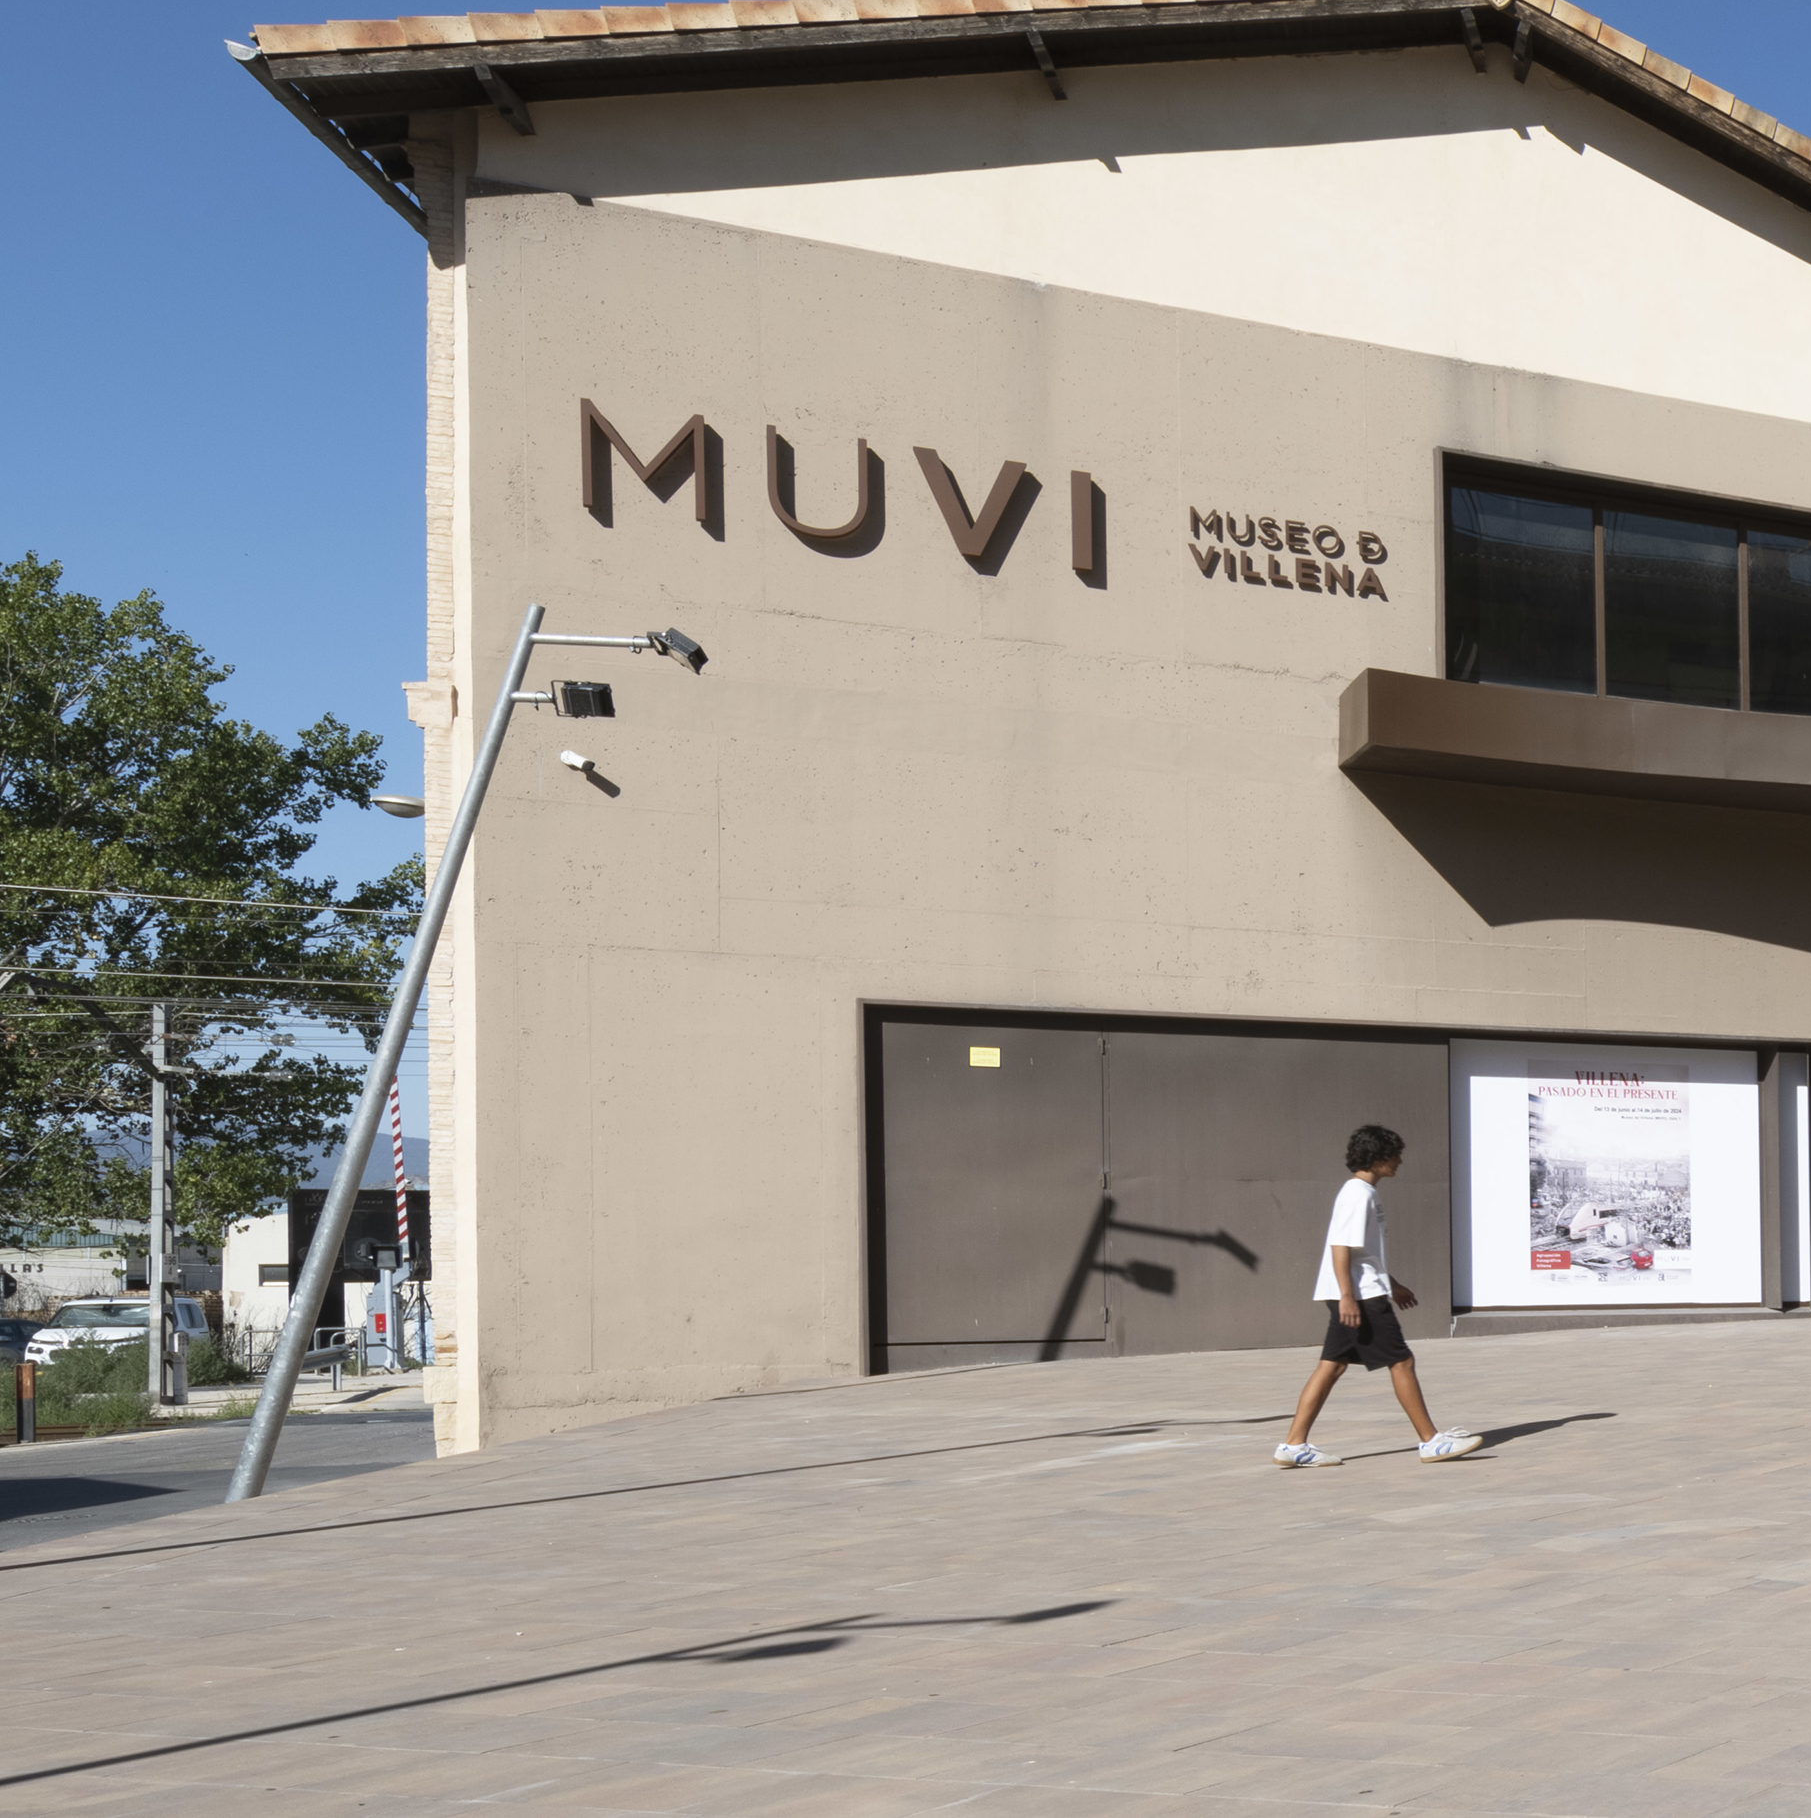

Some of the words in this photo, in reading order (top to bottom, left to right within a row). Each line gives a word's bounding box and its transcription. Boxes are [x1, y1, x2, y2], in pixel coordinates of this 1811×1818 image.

[581, 397, 1092, 572] MUVI
[1189, 505, 1341, 552] MUSEO
[1188, 542, 1386, 596] VILLENA
[1538, 1086, 1587, 1098] PASADO
[1590, 1087, 1603, 1098] EN
[1607, 1088, 1620, 1099] EL
[1623, 1088, 1678, 1100] PRESENTE
[1574, 1070, 1645, 1087] VILLENA:
